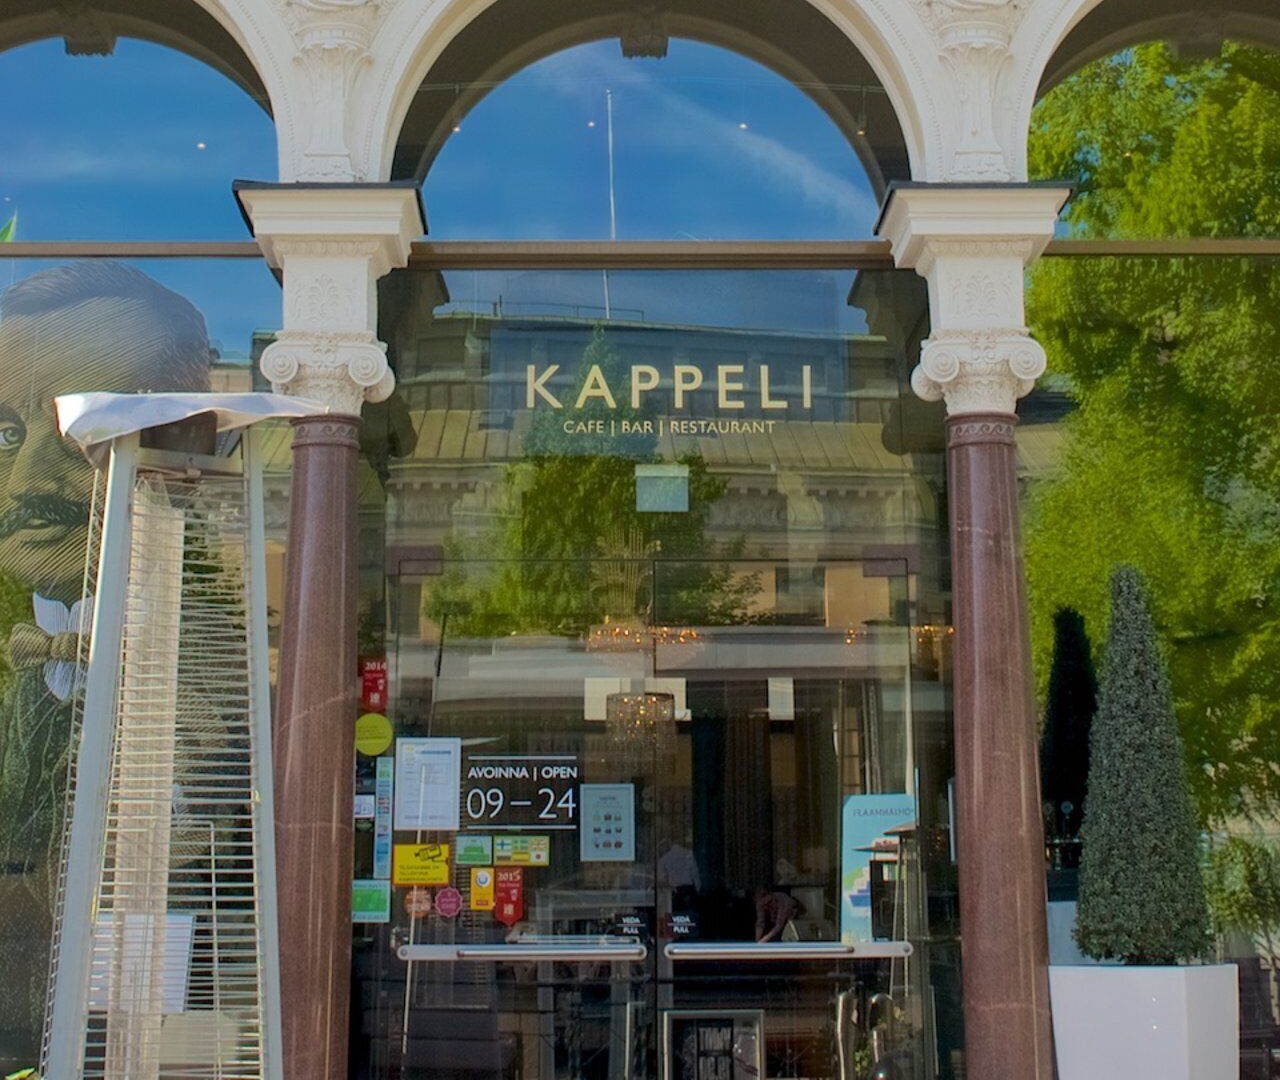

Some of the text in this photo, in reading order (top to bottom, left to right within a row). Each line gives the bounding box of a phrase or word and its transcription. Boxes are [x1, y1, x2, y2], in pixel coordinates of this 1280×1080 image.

[526, 364, 812, 409] KAPPELI
[563, 420, 604, 434] CAFE
[621, 420, 654, 434] BAR
[669, 420, 775, 434] RESTAURANT
[365, 661, 387, 671] 2014
[467, 766, 529, 779] AVOINNA
[541, 766, 578, 779] OPEN
[466, 787, 504, 819] 09
[537, 787, 577, 819] 24
[497, 870, 521, 882] 2015
